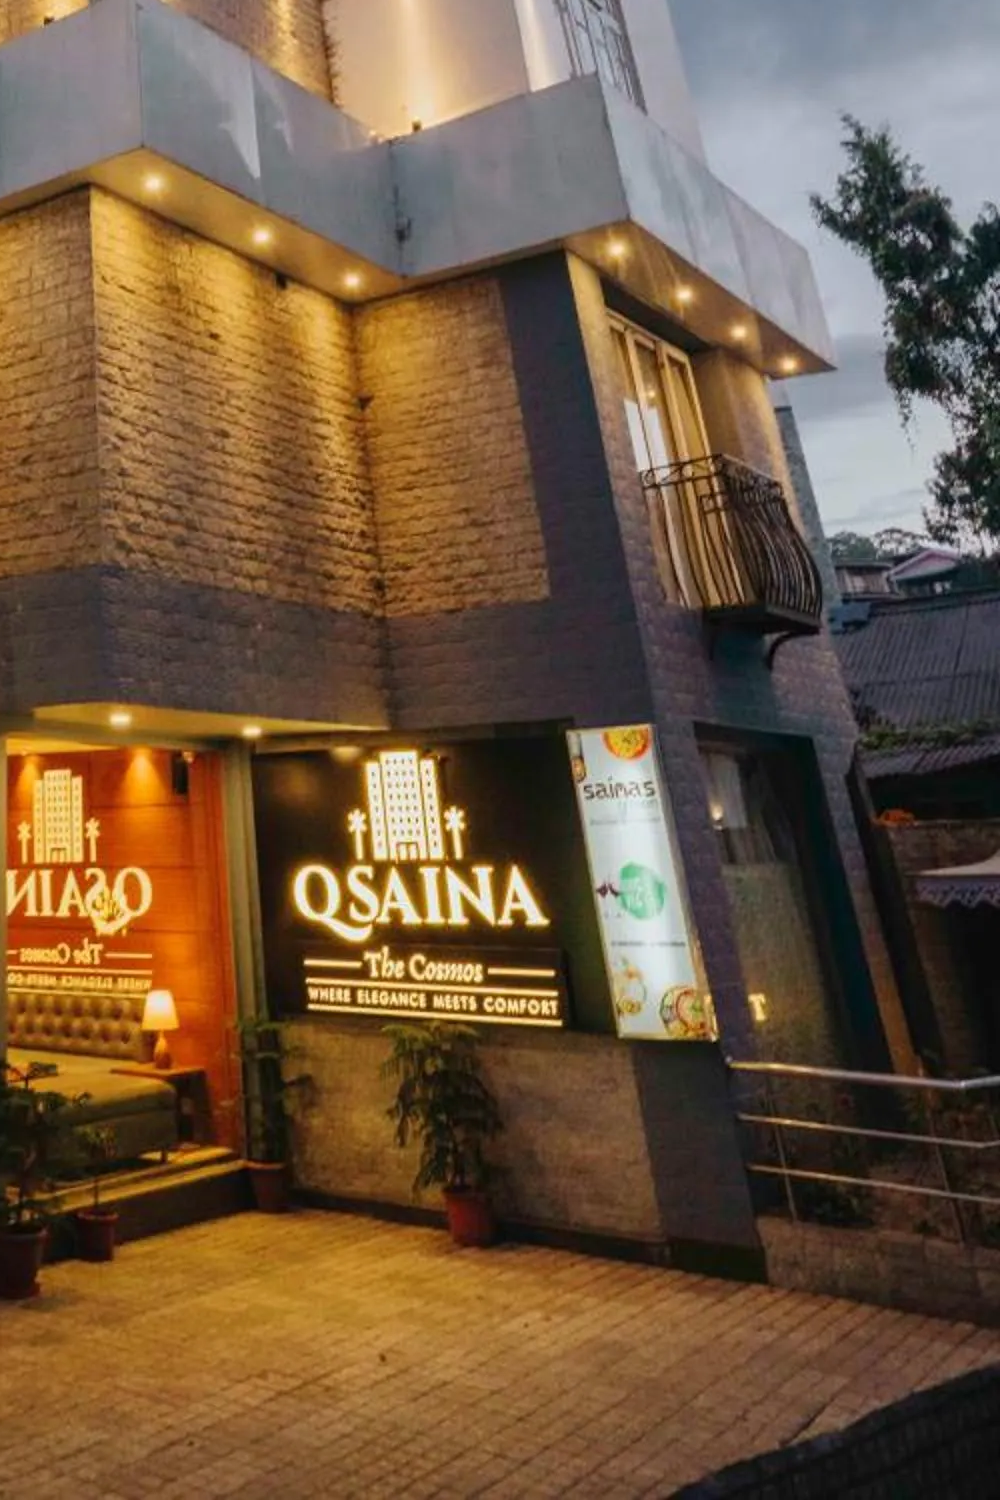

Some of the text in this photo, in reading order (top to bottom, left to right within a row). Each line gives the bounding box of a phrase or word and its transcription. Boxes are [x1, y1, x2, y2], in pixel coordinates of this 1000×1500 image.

[293, 863, 551, 942] QSAINA
[363, 946, 484, 983] The Cosmos
[307, 986, 560, 1016] WHERE ELEGANCE MEETS COMFORT
